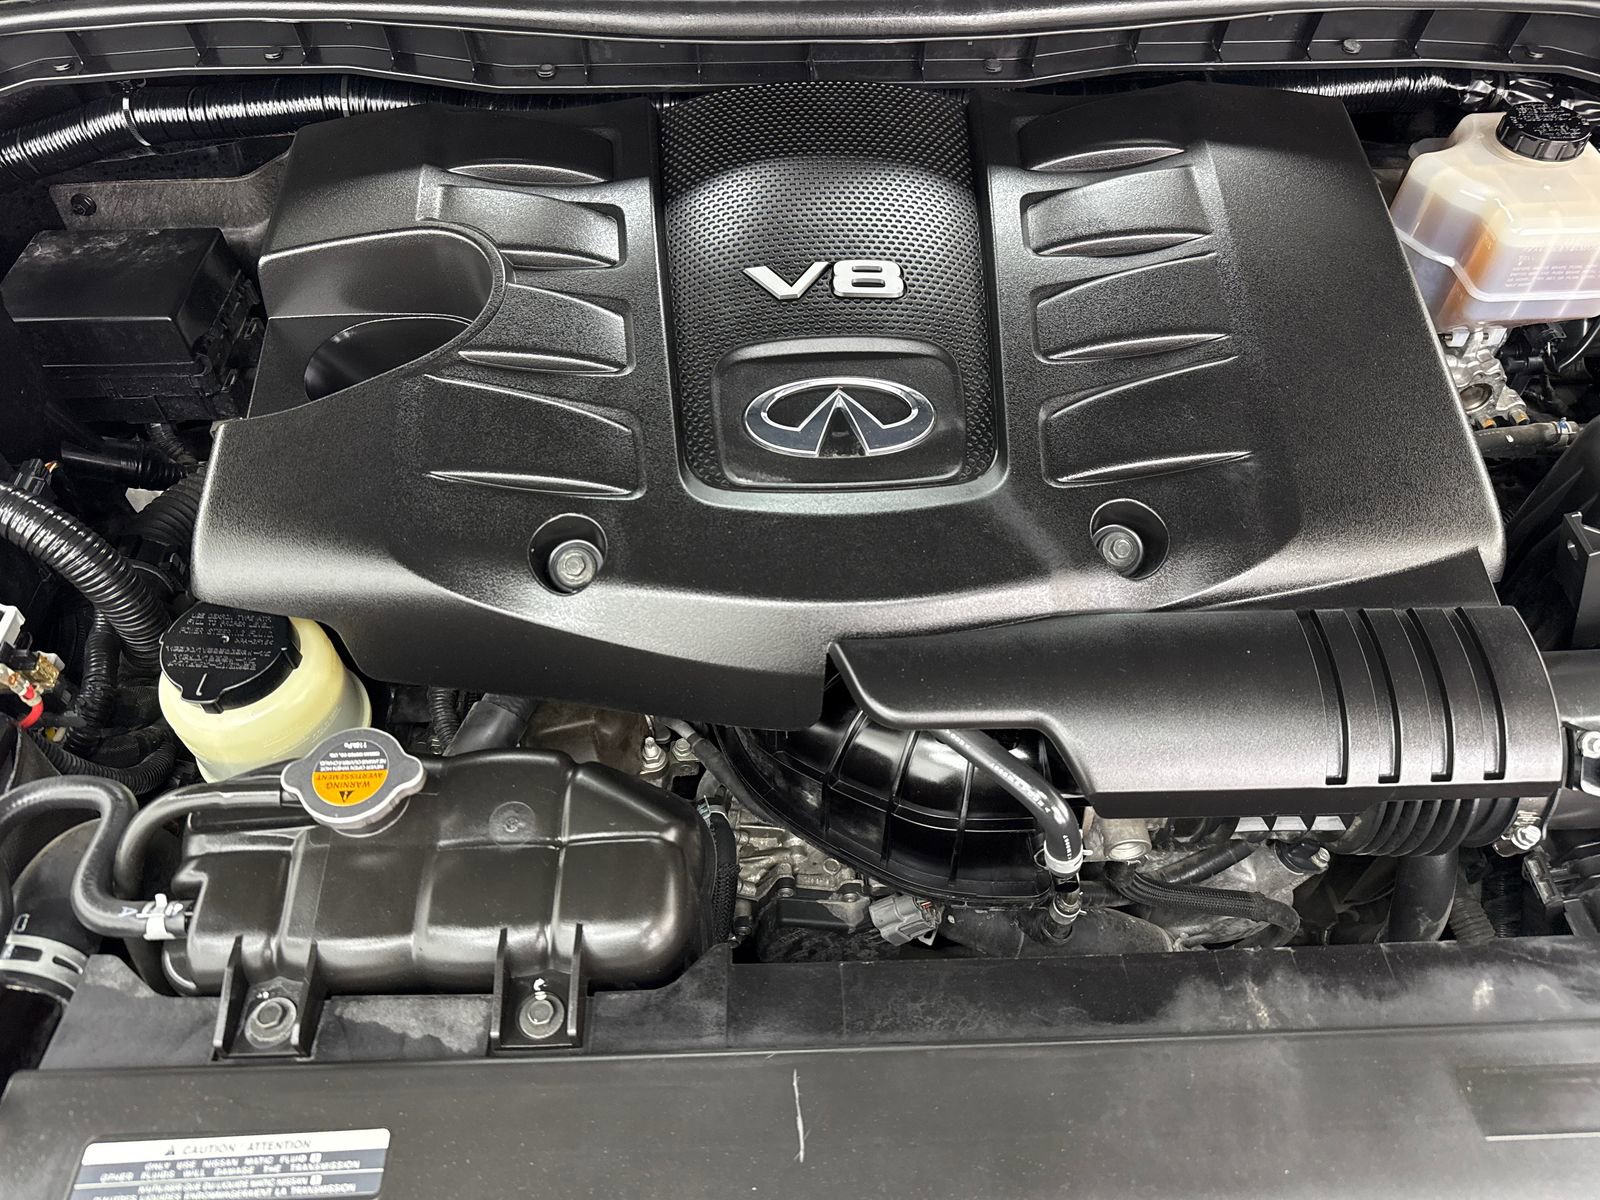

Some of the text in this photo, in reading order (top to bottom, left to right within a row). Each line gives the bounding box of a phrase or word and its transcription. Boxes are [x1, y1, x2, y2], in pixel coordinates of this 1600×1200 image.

[742, 259, 905, 300] V8
[315, 772, 384, 781] AVERTISSEMENT
[325, 780, 371, 790] WARNING
[183, 1139, 311, 1155] CAUTION ATTENTION
[202, 1157, 239, 1169] NISSAN
